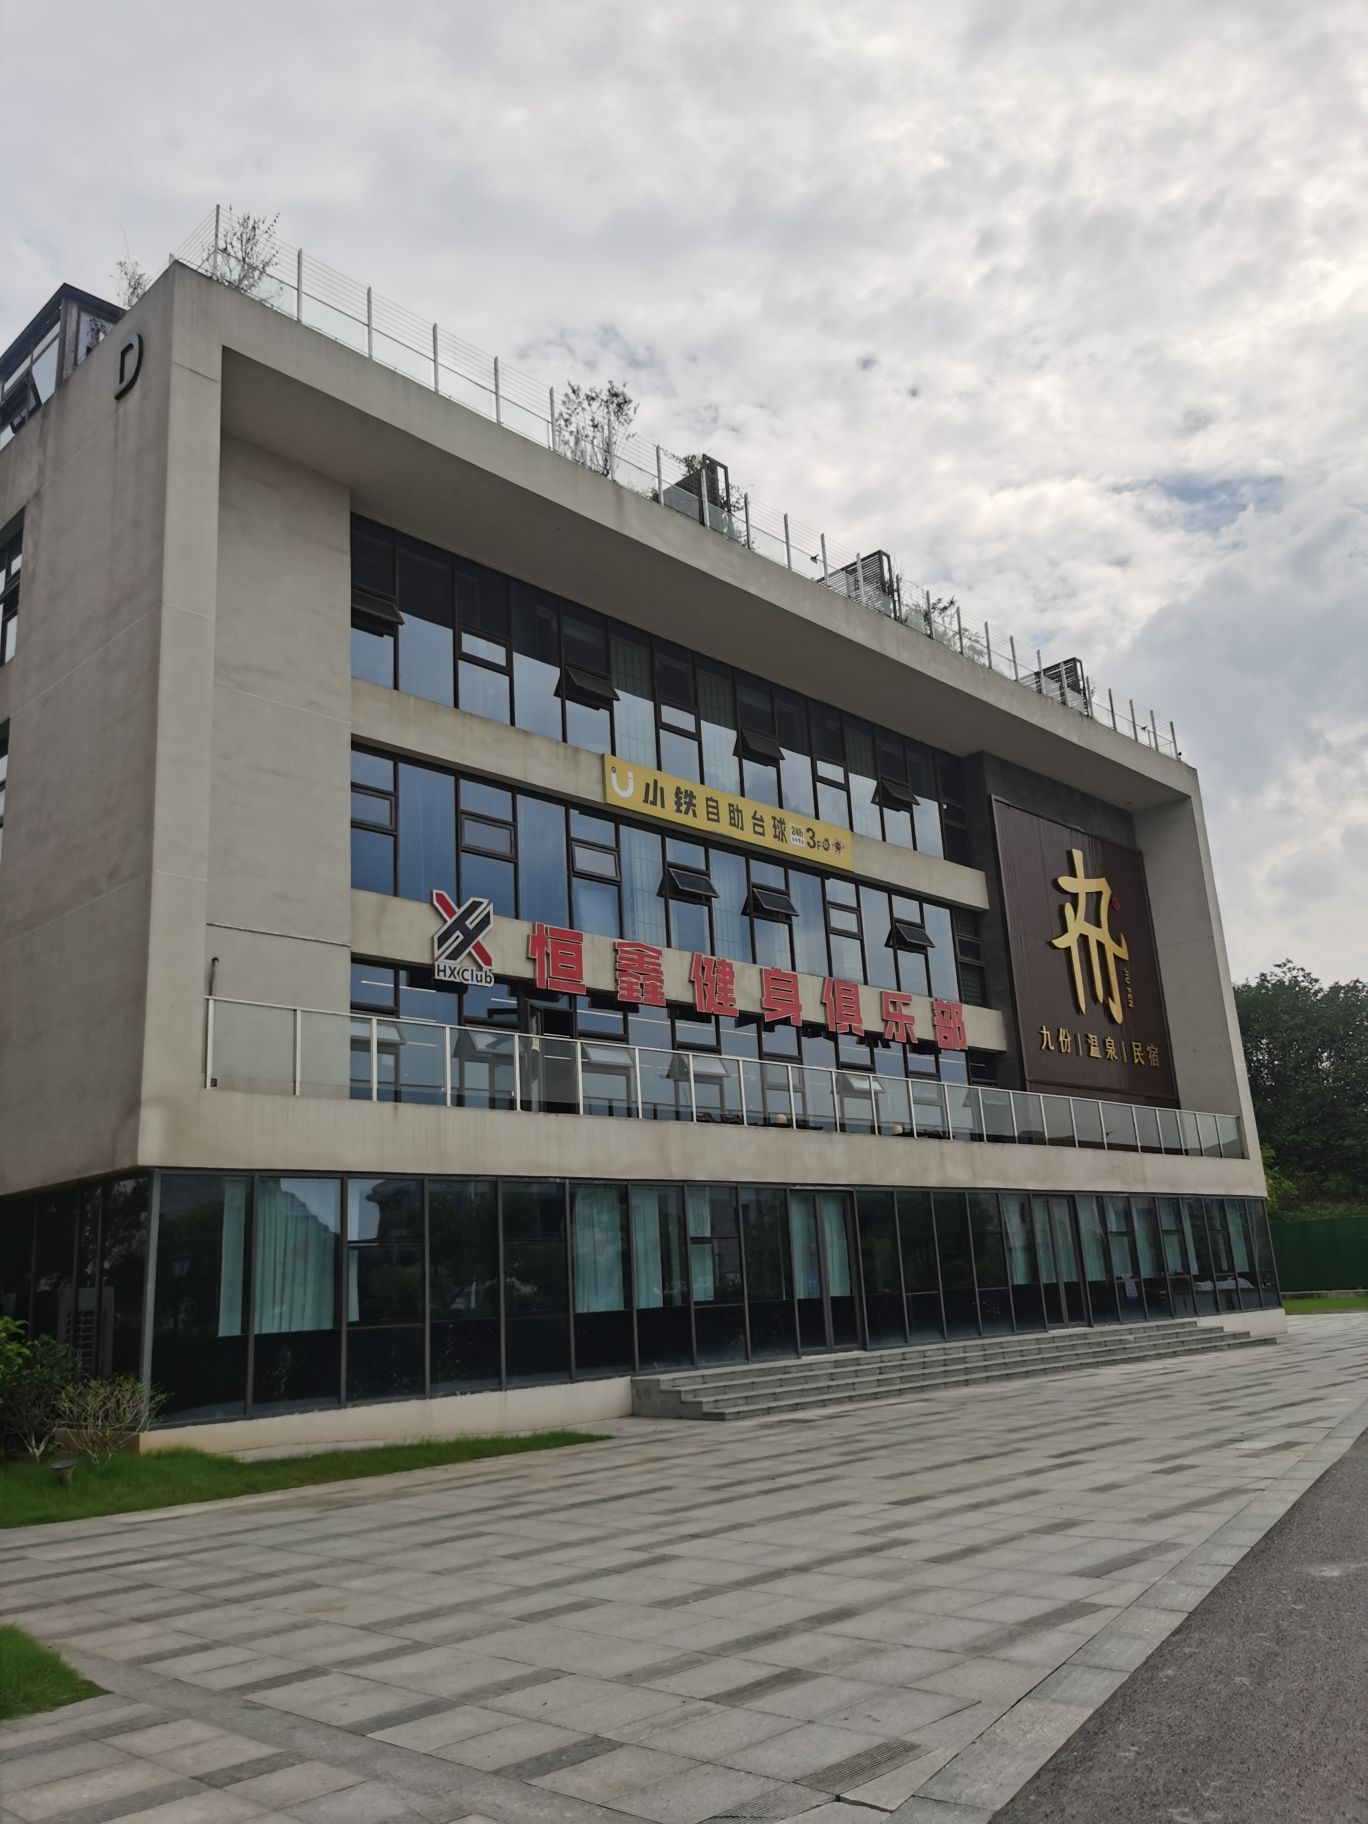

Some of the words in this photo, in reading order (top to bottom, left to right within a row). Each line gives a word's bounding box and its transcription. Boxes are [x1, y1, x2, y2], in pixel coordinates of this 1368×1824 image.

[114, 333, 143, 400] D
[642, 778, 788, 844] 小铁自助台球
[528, 922, 968, 1051] 恒鑫健身俱乐部
